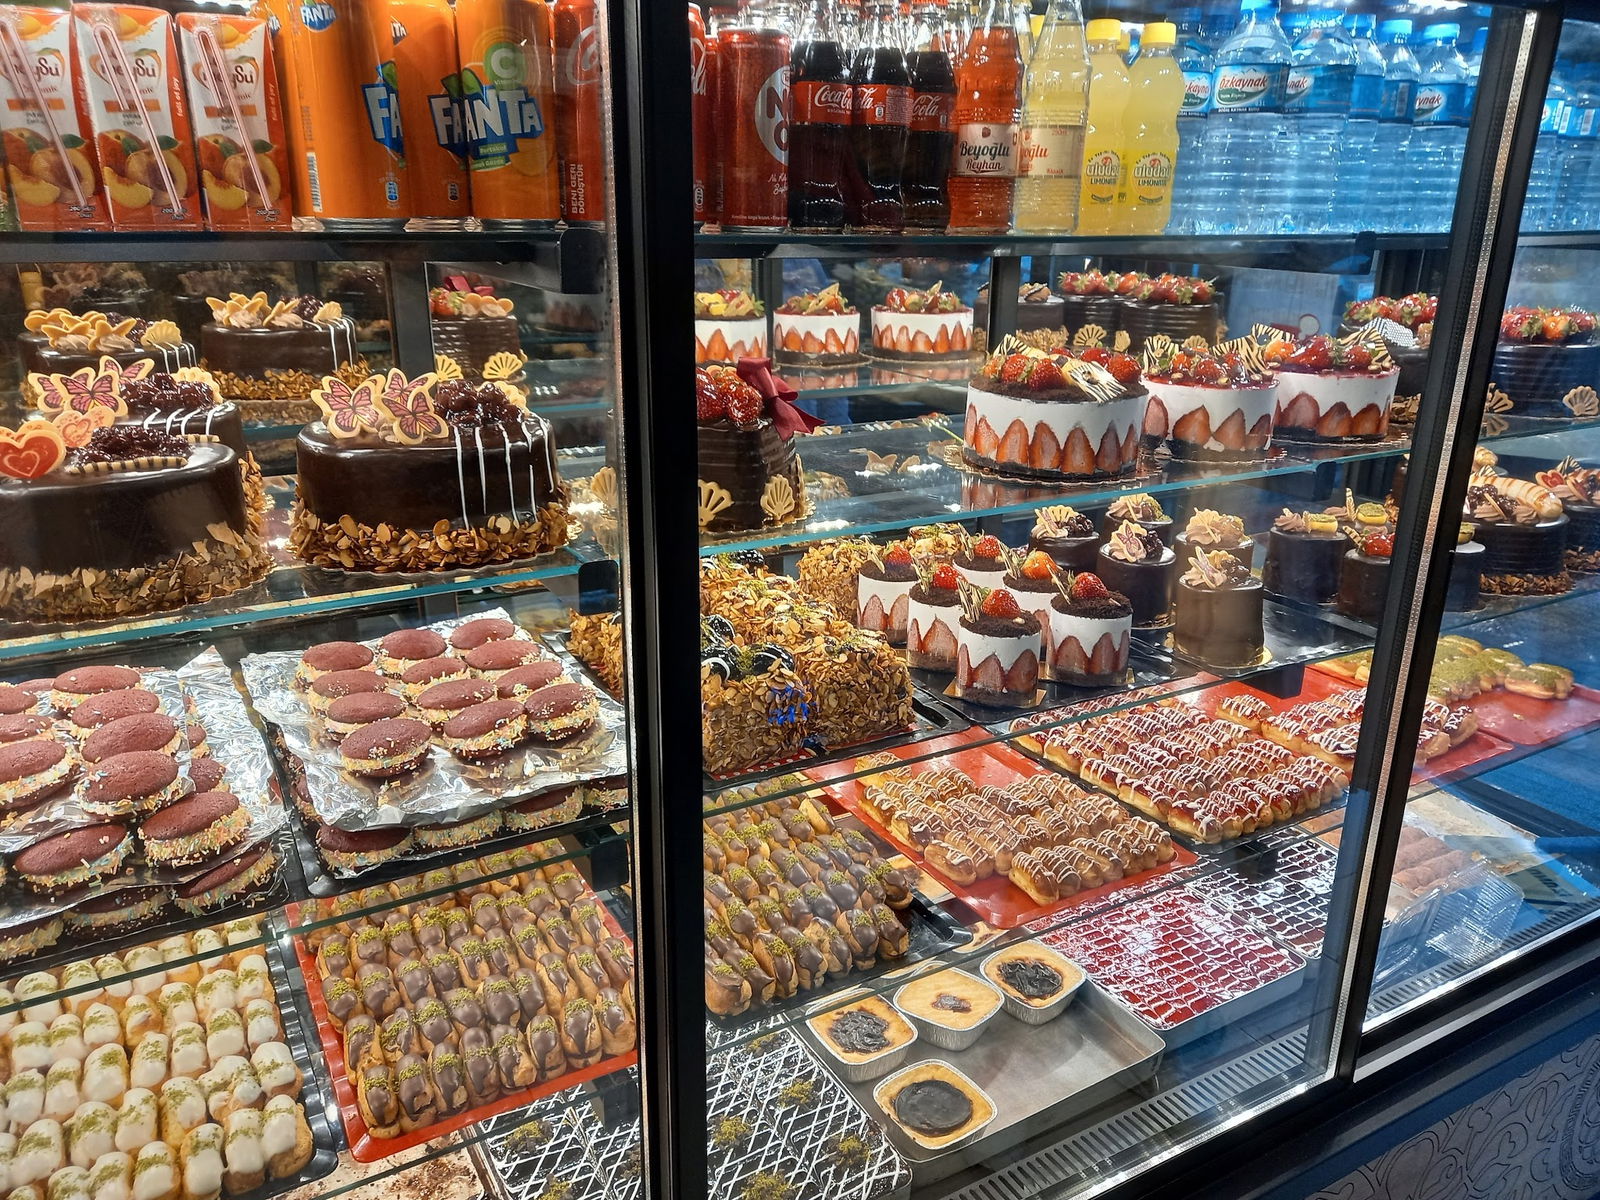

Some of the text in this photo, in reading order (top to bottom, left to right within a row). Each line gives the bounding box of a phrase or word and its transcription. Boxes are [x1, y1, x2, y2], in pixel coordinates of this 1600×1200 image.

[300, 4, 336, 26] FANTA
[960, 141, 1010, 161] Beyoğlu
[965, 159, 1002, 174] Reyhan
